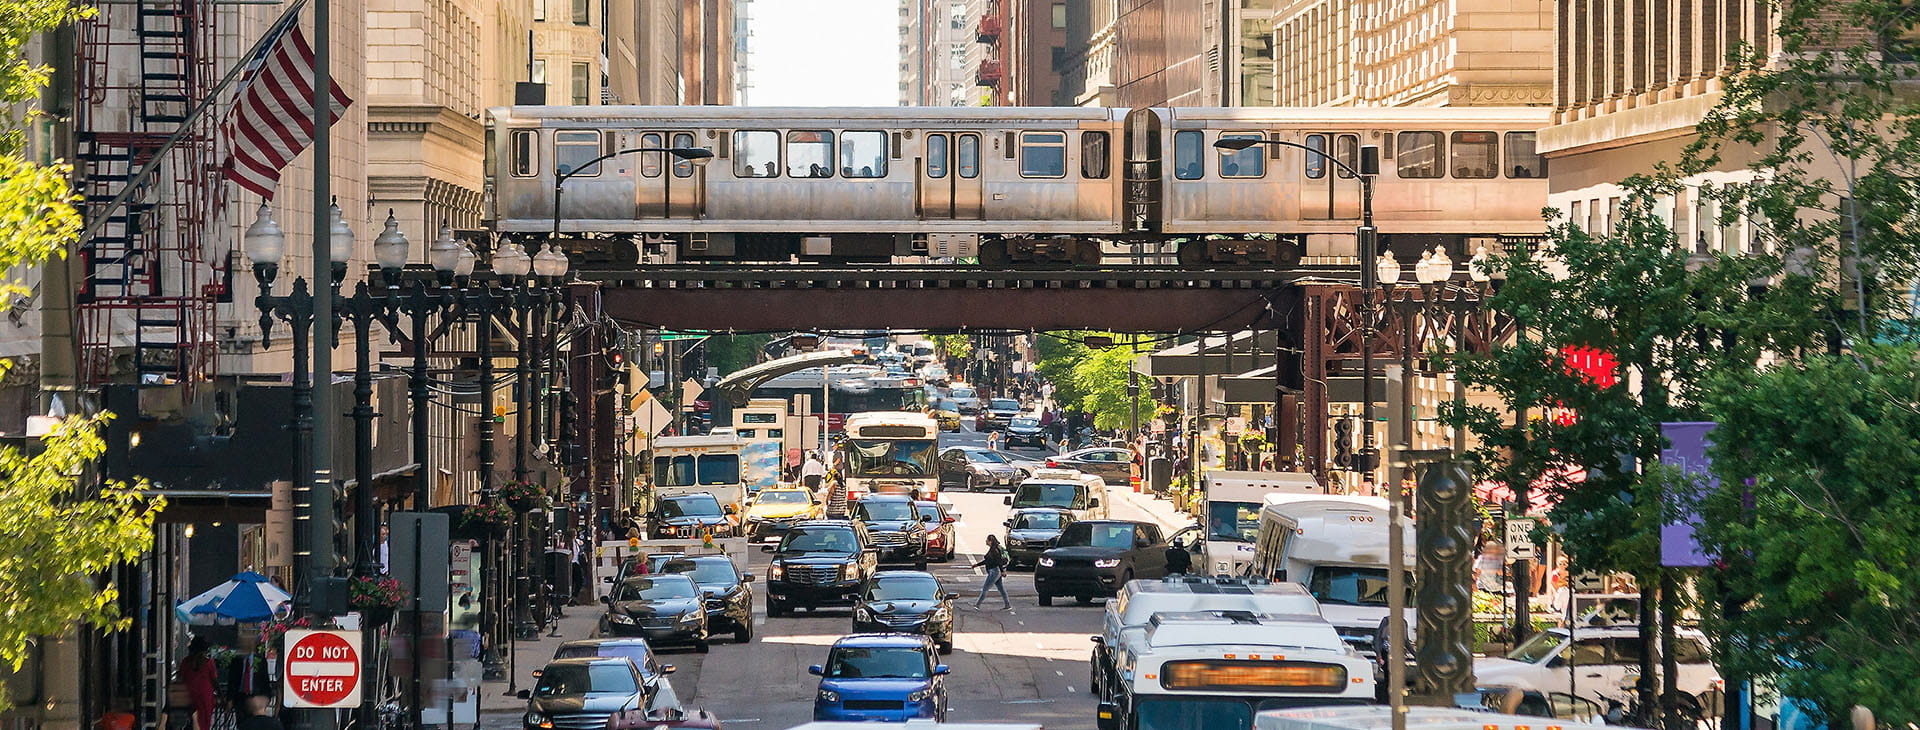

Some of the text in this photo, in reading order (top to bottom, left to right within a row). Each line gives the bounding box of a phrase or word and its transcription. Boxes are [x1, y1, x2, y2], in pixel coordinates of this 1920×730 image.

[1510, 523, 1531, 533] ONE
[1510, 533, 1530, 543] WAY
[296, 646, 350, 659] DO NOT
[301, 679, 344, 692] ENTER
